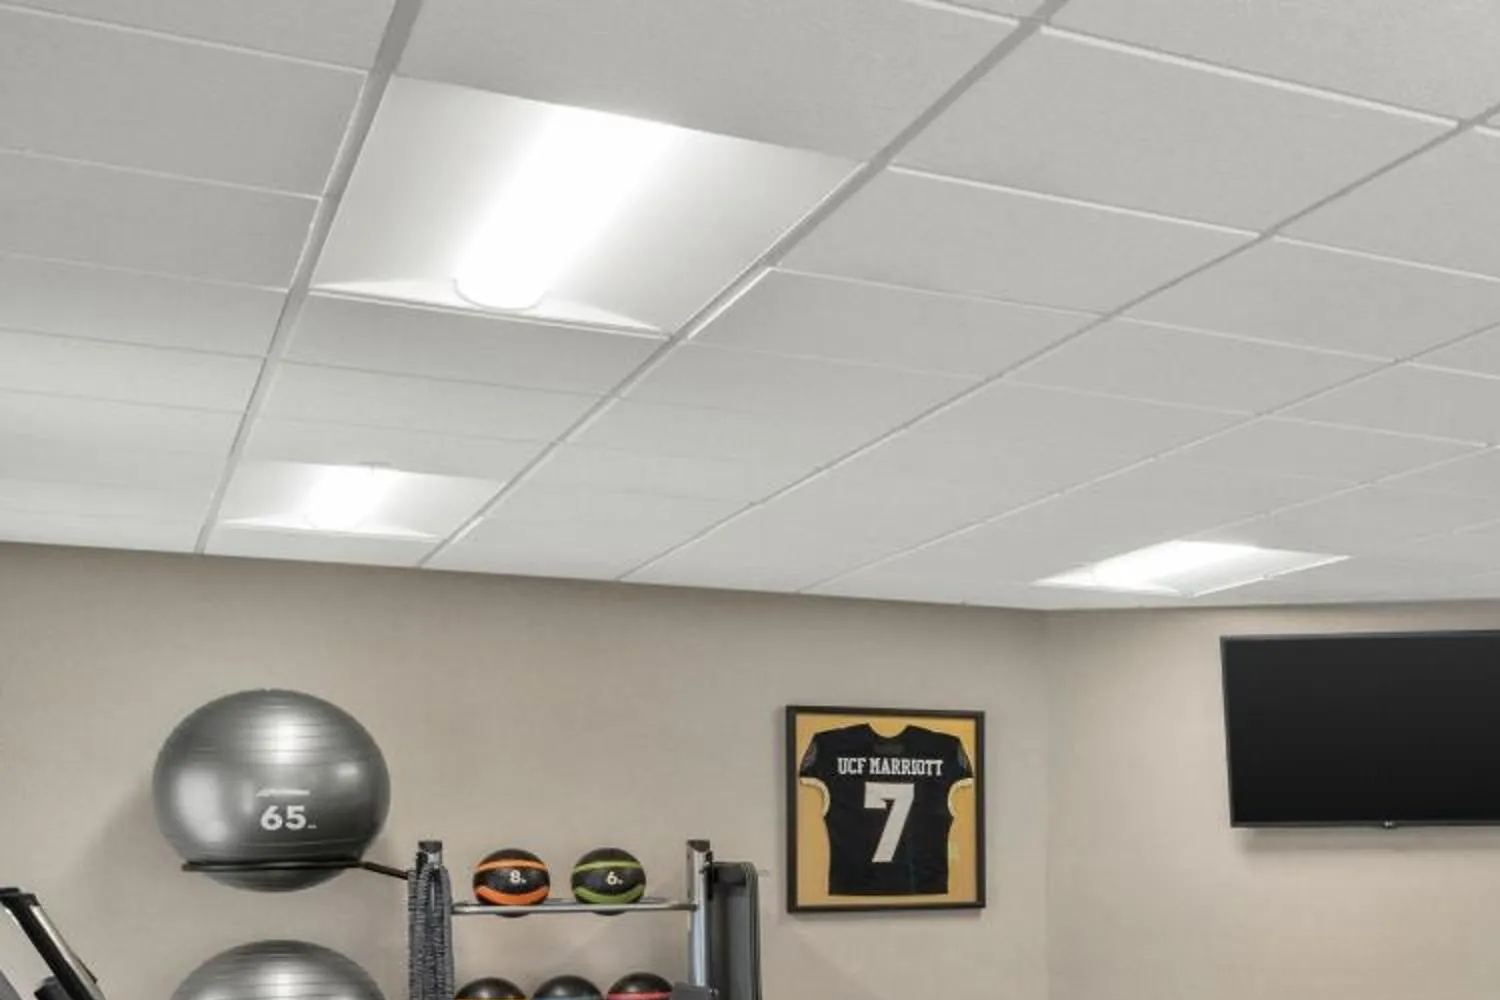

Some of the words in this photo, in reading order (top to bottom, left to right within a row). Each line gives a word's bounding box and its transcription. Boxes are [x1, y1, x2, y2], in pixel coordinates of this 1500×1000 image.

[838, 757, 866, 775] UCF
[869, 757, 943, 776] MARRIOTT
[261, 805, 307, 831] 65
[864, 782, 915, 863] 7
[510, 869, 521, 884] 8
[607, 871, 617, 885] 6
